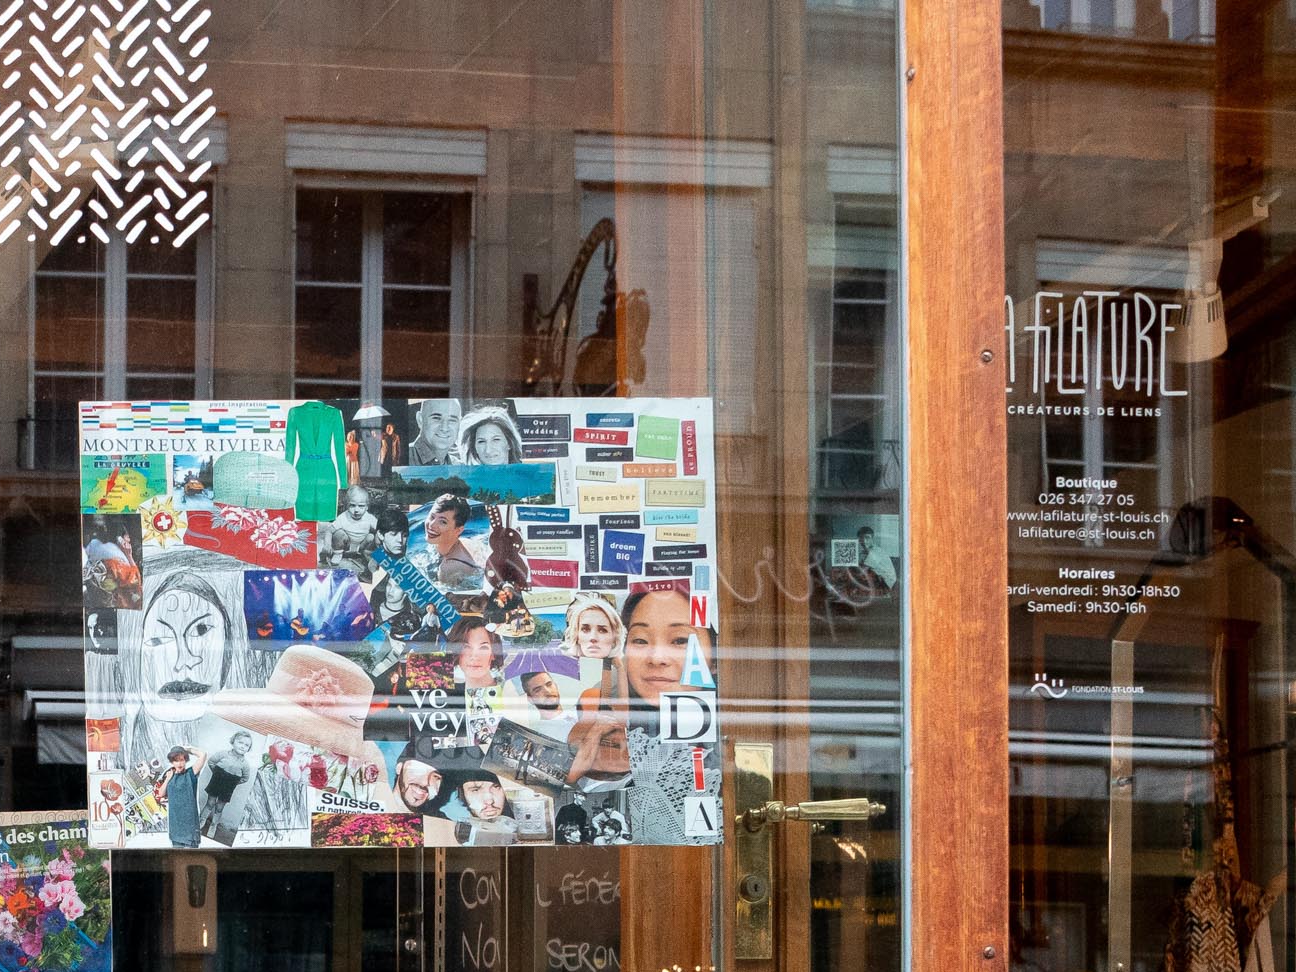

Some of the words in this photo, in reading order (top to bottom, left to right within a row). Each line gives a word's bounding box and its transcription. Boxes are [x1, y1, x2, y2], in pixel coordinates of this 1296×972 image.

[1007, 404, 1090, 416] CRÉATEURS
[1097, 407, 1114, 416] DE
[1121, 408, 1162, 417] LIENS
[523, 428, 559, 436] Wedding
[585, 432, 617, 441] SPIRIT
[83, 438, 196, 452] MONTREUX
[205, 438, 286, 452] RIVIERA
[1056, 477, 1117, 490] Boutique
[1039, 493, 1065, 505] 026
[1069, 494, 1092, 505] 347
[1096, 494, 1113, 506] 27
[1116, 495, 1135, 506] 05
[1006, 510, 1169, 524] www.lafilature-st-louis.ch
[1018, 527, 1155, 541] lafilature@st-louis.ch
[609, 542, 636, 551] dream
[616, 552, 630, 561] BIG
[1059, 568, 1115, 580] Horaires
[648, 583, 672, 591] Live
[1006, 584, 1098, 597] ardi-vendredi:
[1102, 585, 1180, 598] 9h30-18h30
[1085, 602, 1146, 614] 9h30-16h
[1071, 685, 1111, 694] FONDATION
[1111, 685, 1144, 694] ST-LOUIS
[409, 688, 448, 709] ve
[409, 711, 466, 738] vey
[321, 792, 385, 812] Suisse.
[92, 800, 110, 822] 10
[7, 829, 36, 845] des
[39, 826, 86, 841] cham
